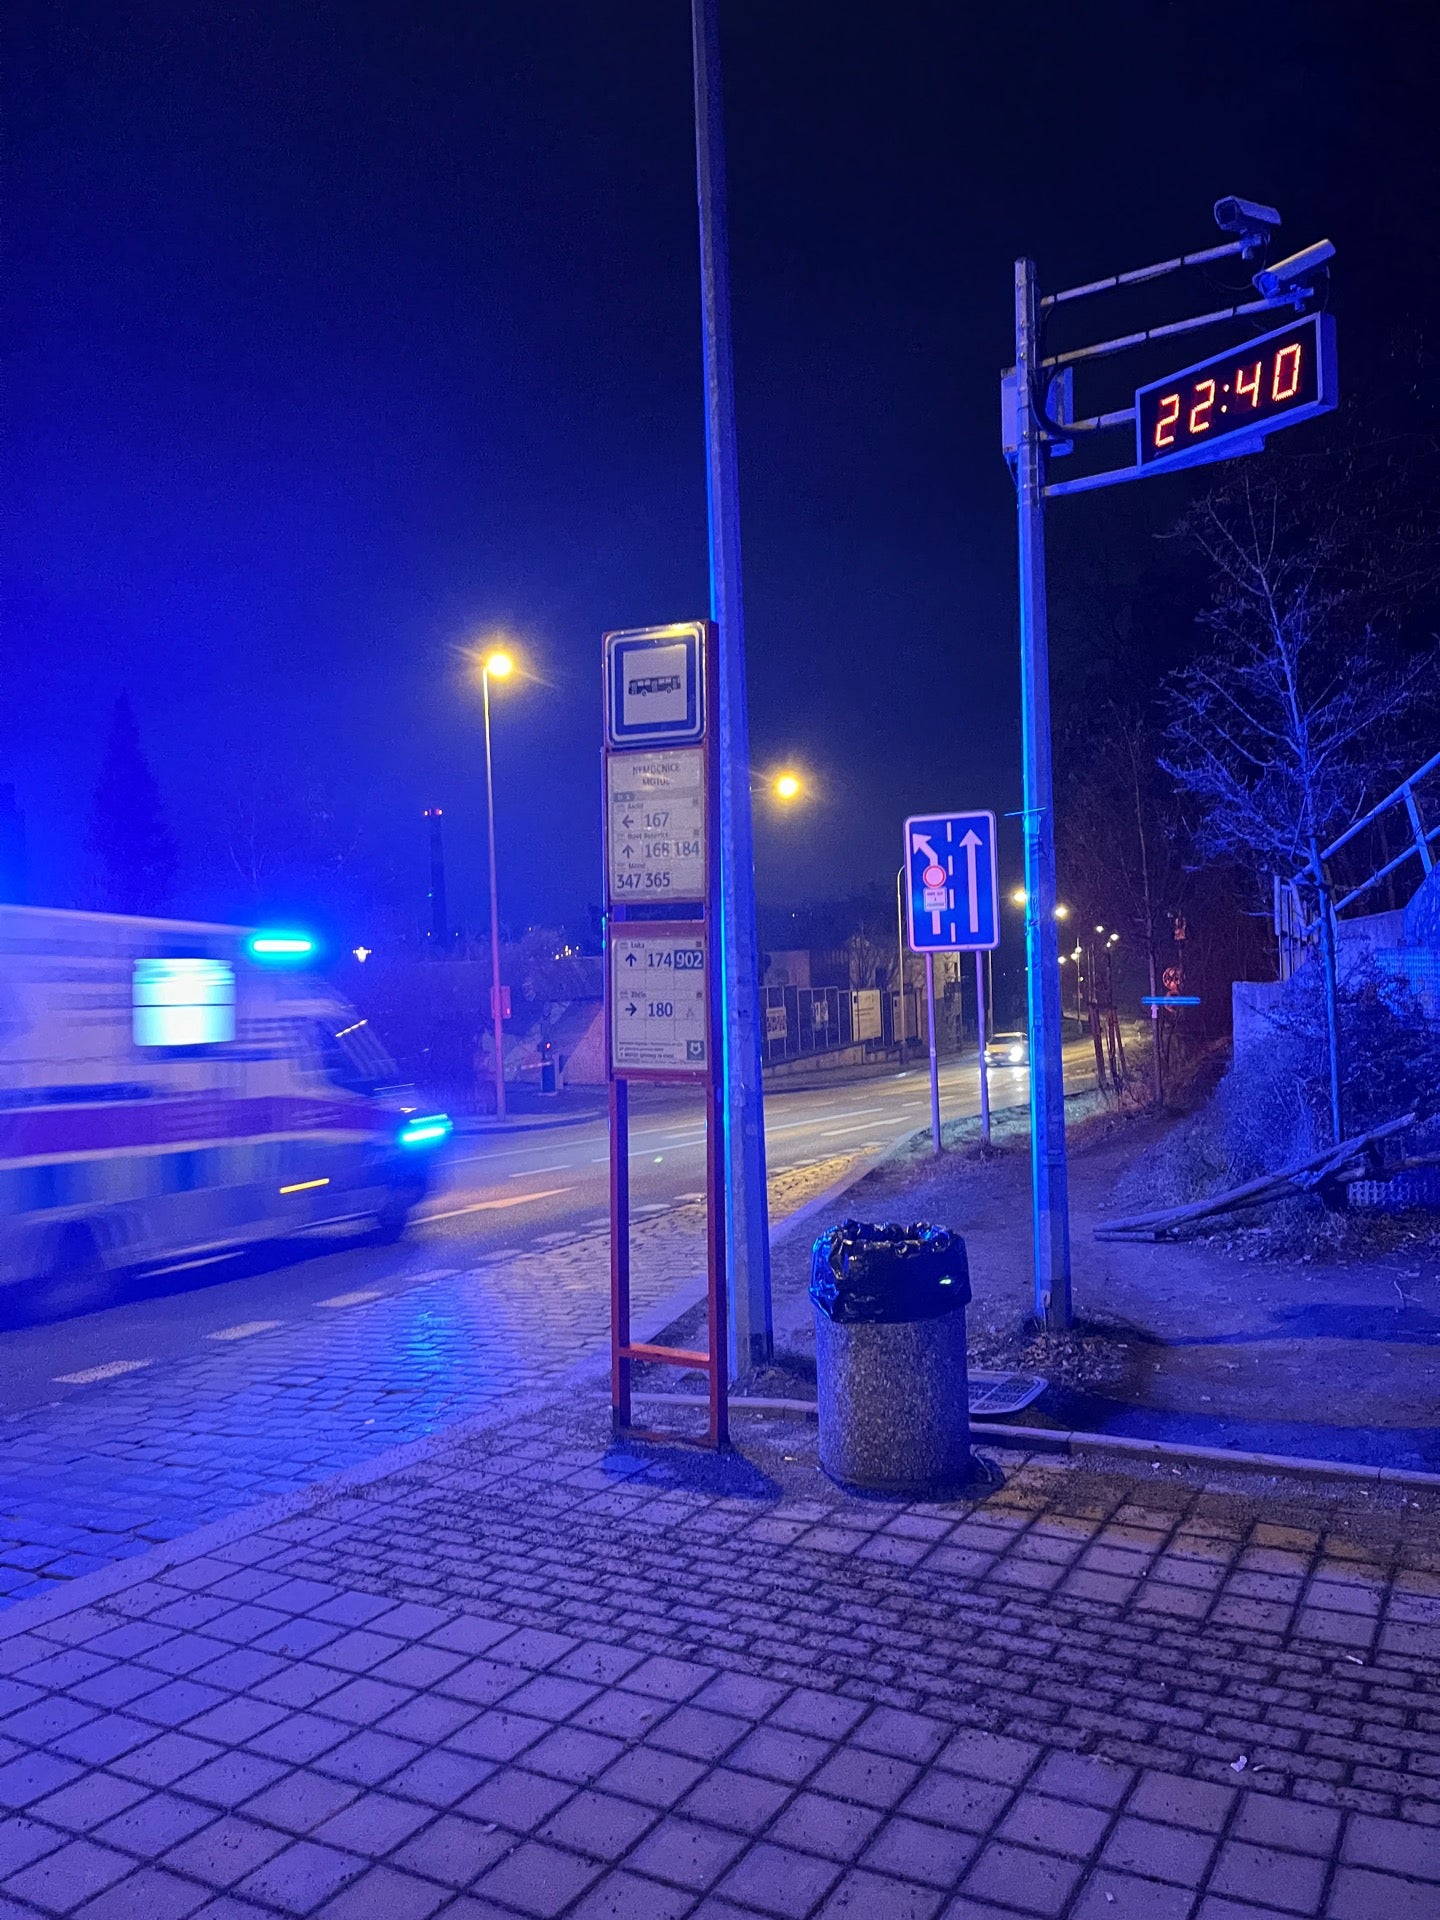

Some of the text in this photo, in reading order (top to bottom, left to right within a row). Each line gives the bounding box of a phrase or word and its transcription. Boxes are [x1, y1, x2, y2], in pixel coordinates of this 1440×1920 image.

[1154, 342, 1301, 448] 22:40
[645, 811, 669, 828] 167
[645, 840, 700, 858] 168 184
[616, 871, 670, 889] 347 365
[648, 951, 702, 968] 174 902
[648, 1001, 673, 1017] 180
